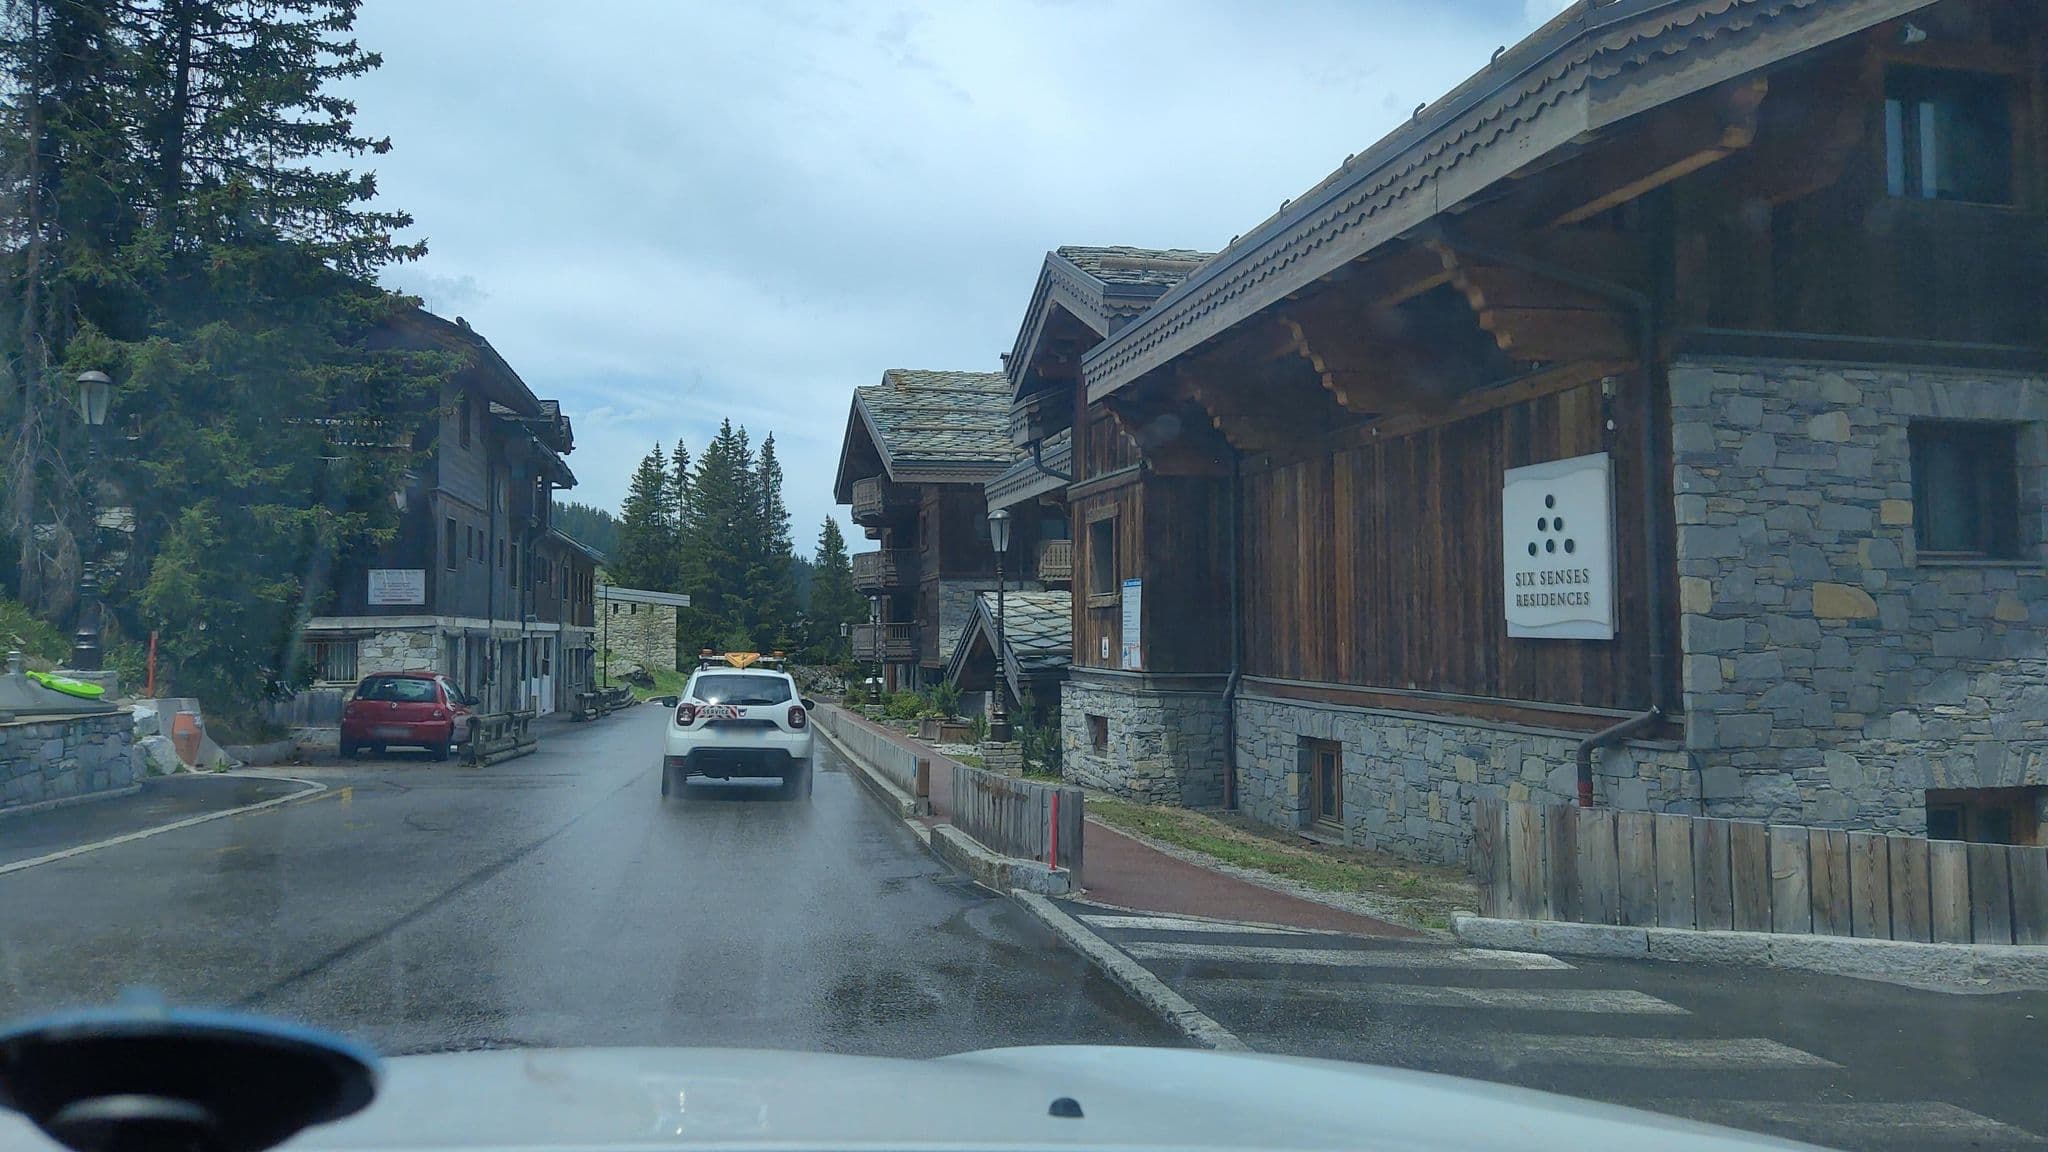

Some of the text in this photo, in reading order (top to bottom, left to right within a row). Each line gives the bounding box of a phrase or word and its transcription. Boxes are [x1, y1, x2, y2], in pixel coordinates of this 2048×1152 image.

[1515, 568, 1589, 587] SIX SENSES
[1516, 591, 1590, 607] RESIDENCES
